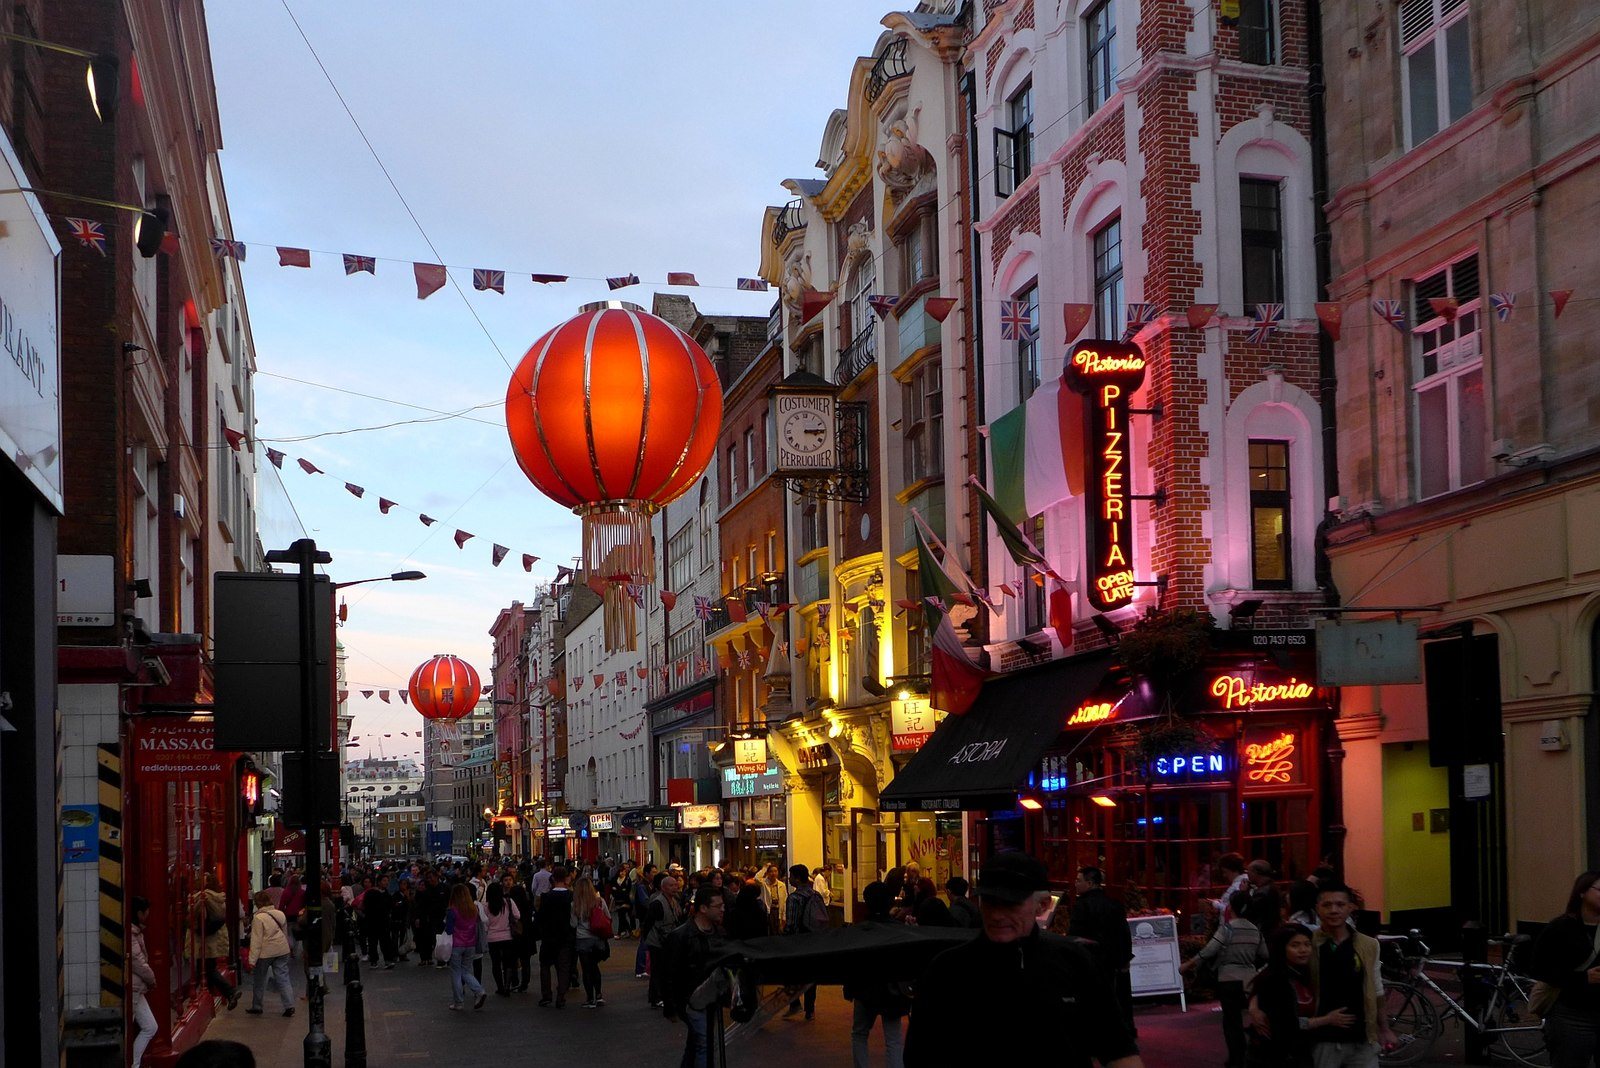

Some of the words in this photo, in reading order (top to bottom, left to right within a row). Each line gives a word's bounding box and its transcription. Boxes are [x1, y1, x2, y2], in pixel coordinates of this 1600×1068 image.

[0, 296, 45, 399] RANT
[1076, 349, 1145, 374] Astoria
[779, 396, 831, 416] COSTUMIER
[780, 447, 832, 467] PERRUQUIER
[1103, 384, 1126, 567] PIZZERIA
[1097, 570, 1134, 590] OPEN
[1103, 583, 1134, 603] LATE
[1253, 635, 1268, 645] 020
[1268, 635, 1286, 645] 7437
[1287, 635, 1306, 645] 6523
[1212, 675, 1314, 709] Astoria
[903, 700, 925, 732] 旺記
[139, 737, 215, 751] MASSAG
[894, 734, 921, 748] Wong
[947, 737, 1009, 765] ASTORIA
[141, 763, 221, 772] redlotusspa.co.uk
[736, 765, 756, 773] Wong
[756, 764, 766, 772] Kei
[1157, 754, 1223, 775] OPEN
[590, 813, 611, 823] OPEN
